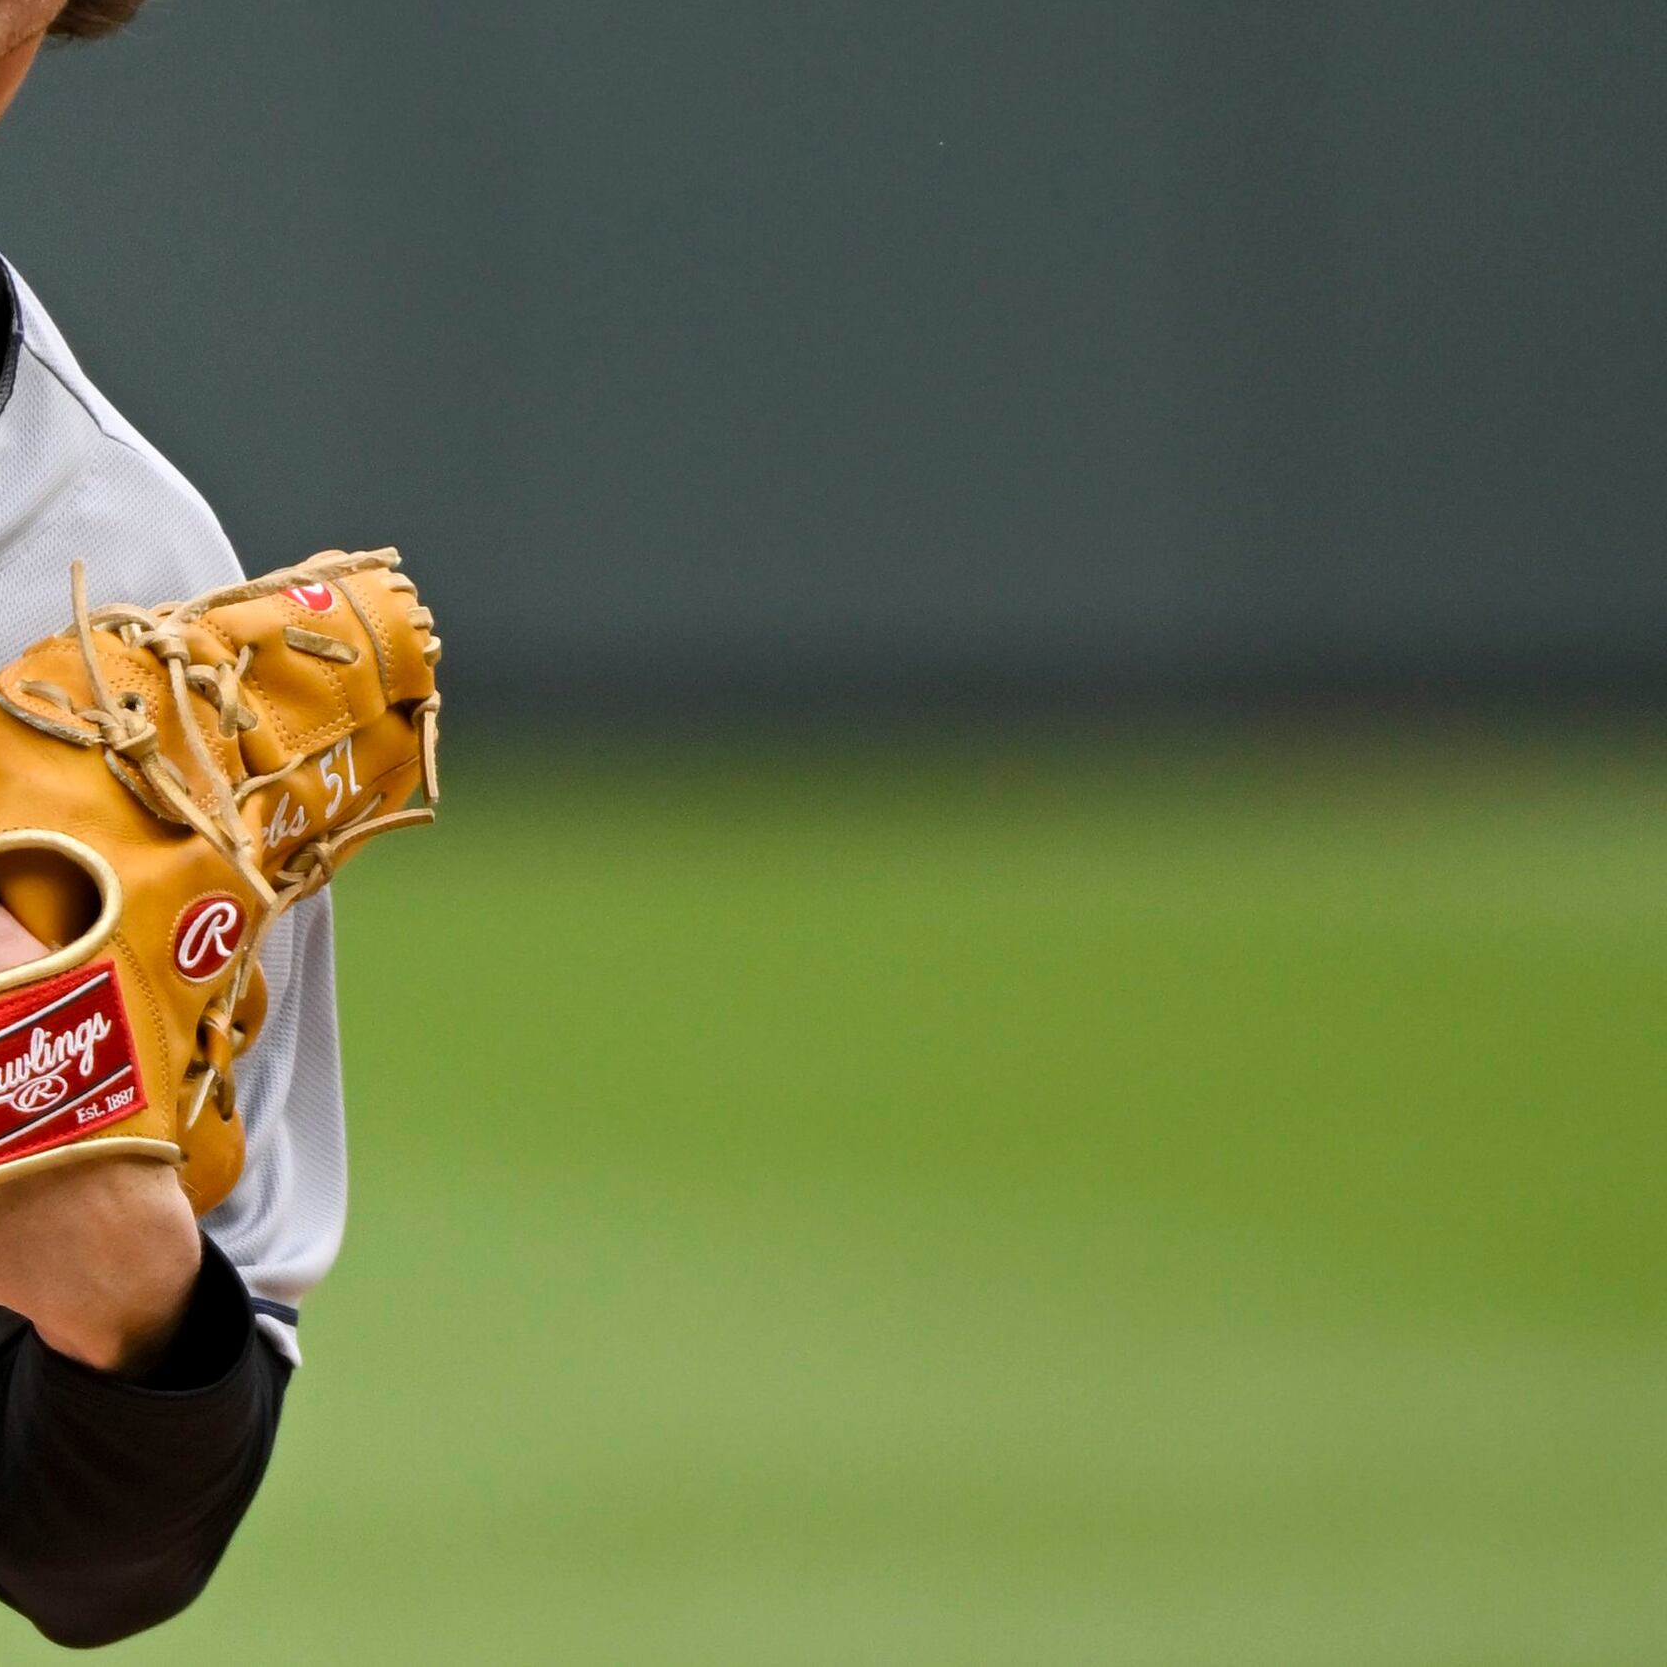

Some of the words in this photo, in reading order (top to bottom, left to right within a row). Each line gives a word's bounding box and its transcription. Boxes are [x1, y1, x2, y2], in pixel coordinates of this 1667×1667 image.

[319, 735, 363, 819] 57
[177, 901, 237, 969] R
[76, 1101, 105, 1124] Est.
[105, 1085, 136, 1113] 1887
